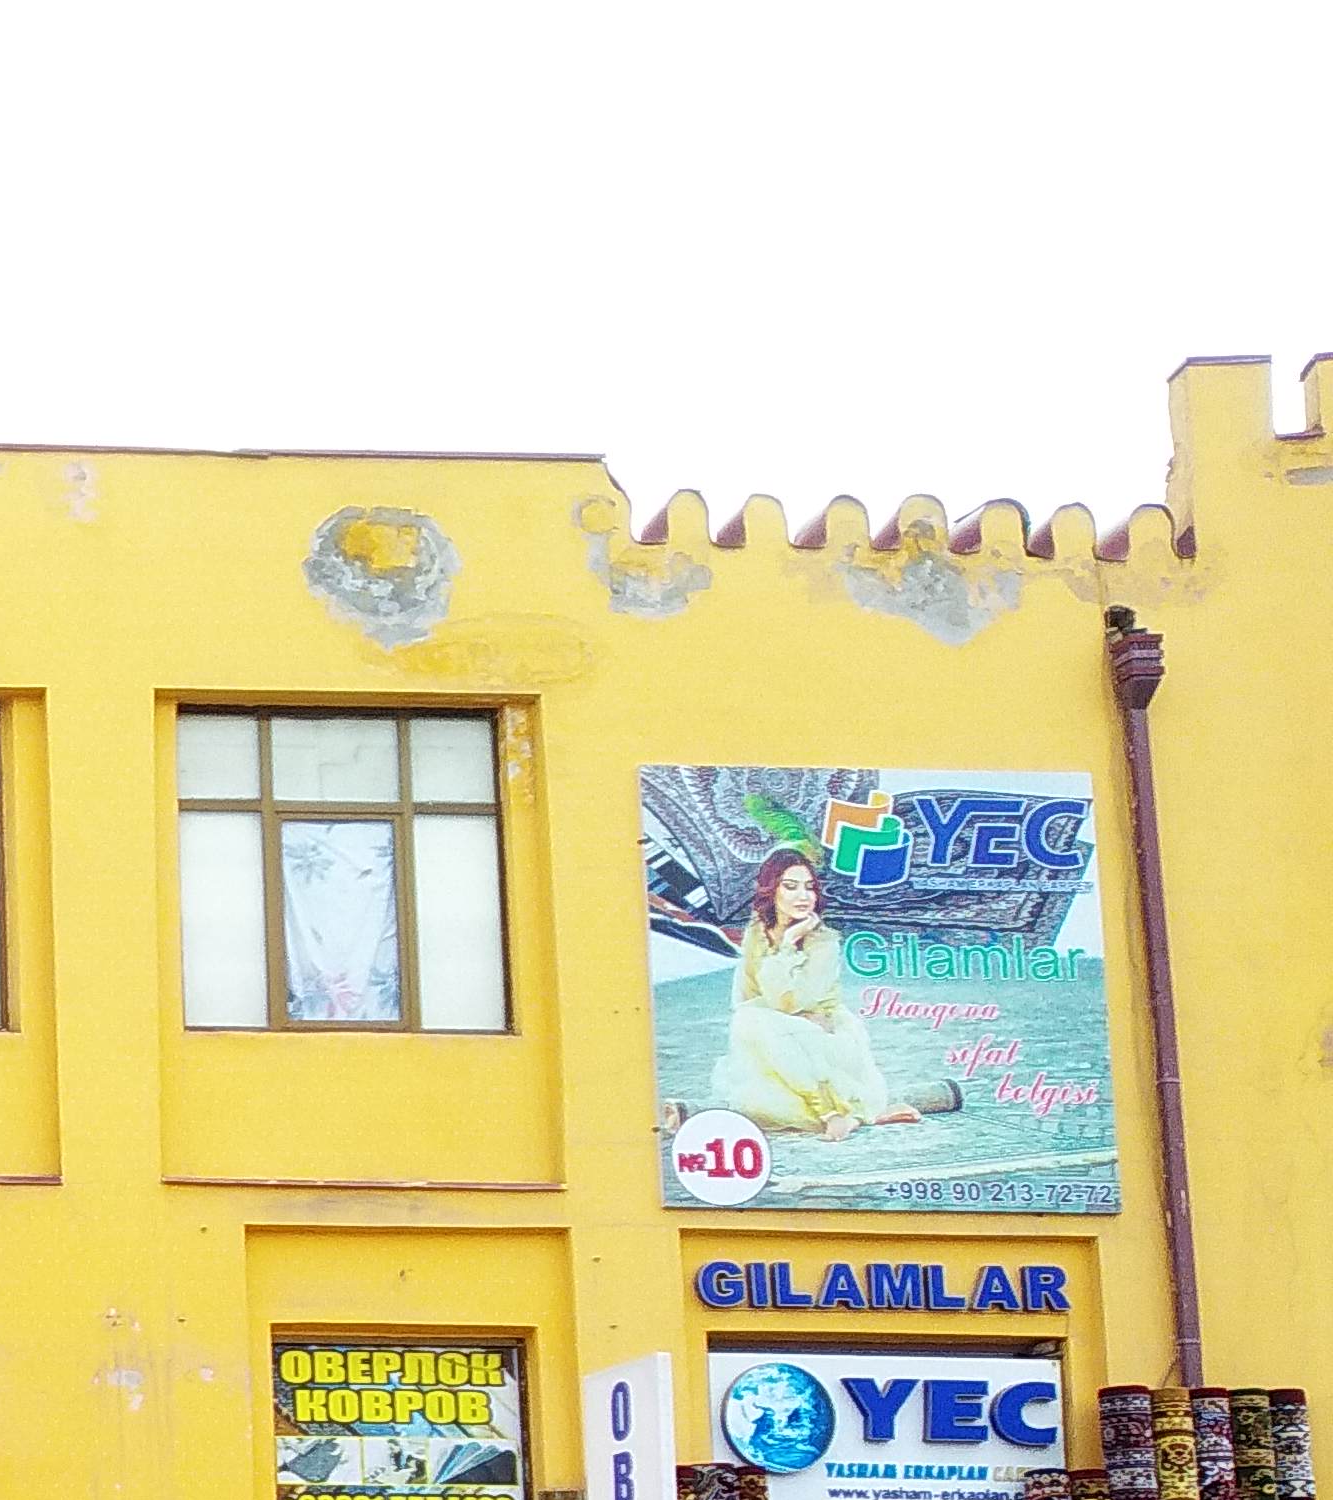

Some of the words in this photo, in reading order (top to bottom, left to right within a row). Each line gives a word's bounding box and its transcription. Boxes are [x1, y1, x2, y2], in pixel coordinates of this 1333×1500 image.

[913, 797, 1086, 870] YEC
[845, 932, 1084, 981] Gilamlar
[884, 1182, 943, 1201] +998
[952, 1183, 981, 1201] 90
[990, 1183, 1113, 1205] 213-72-72
[697, 1260, 1071, 1311] GILAMLAR
[280, 1350, 504, 1386] ОВЕРЛОК
[294, 1389, 491, 1424] КОВРОВ
[840, 1377, 1058, 1446] YEC
[825, 1462, 897, 1479] YASHAM
[903, 1464, 989, 1481] ERKAPLAN
